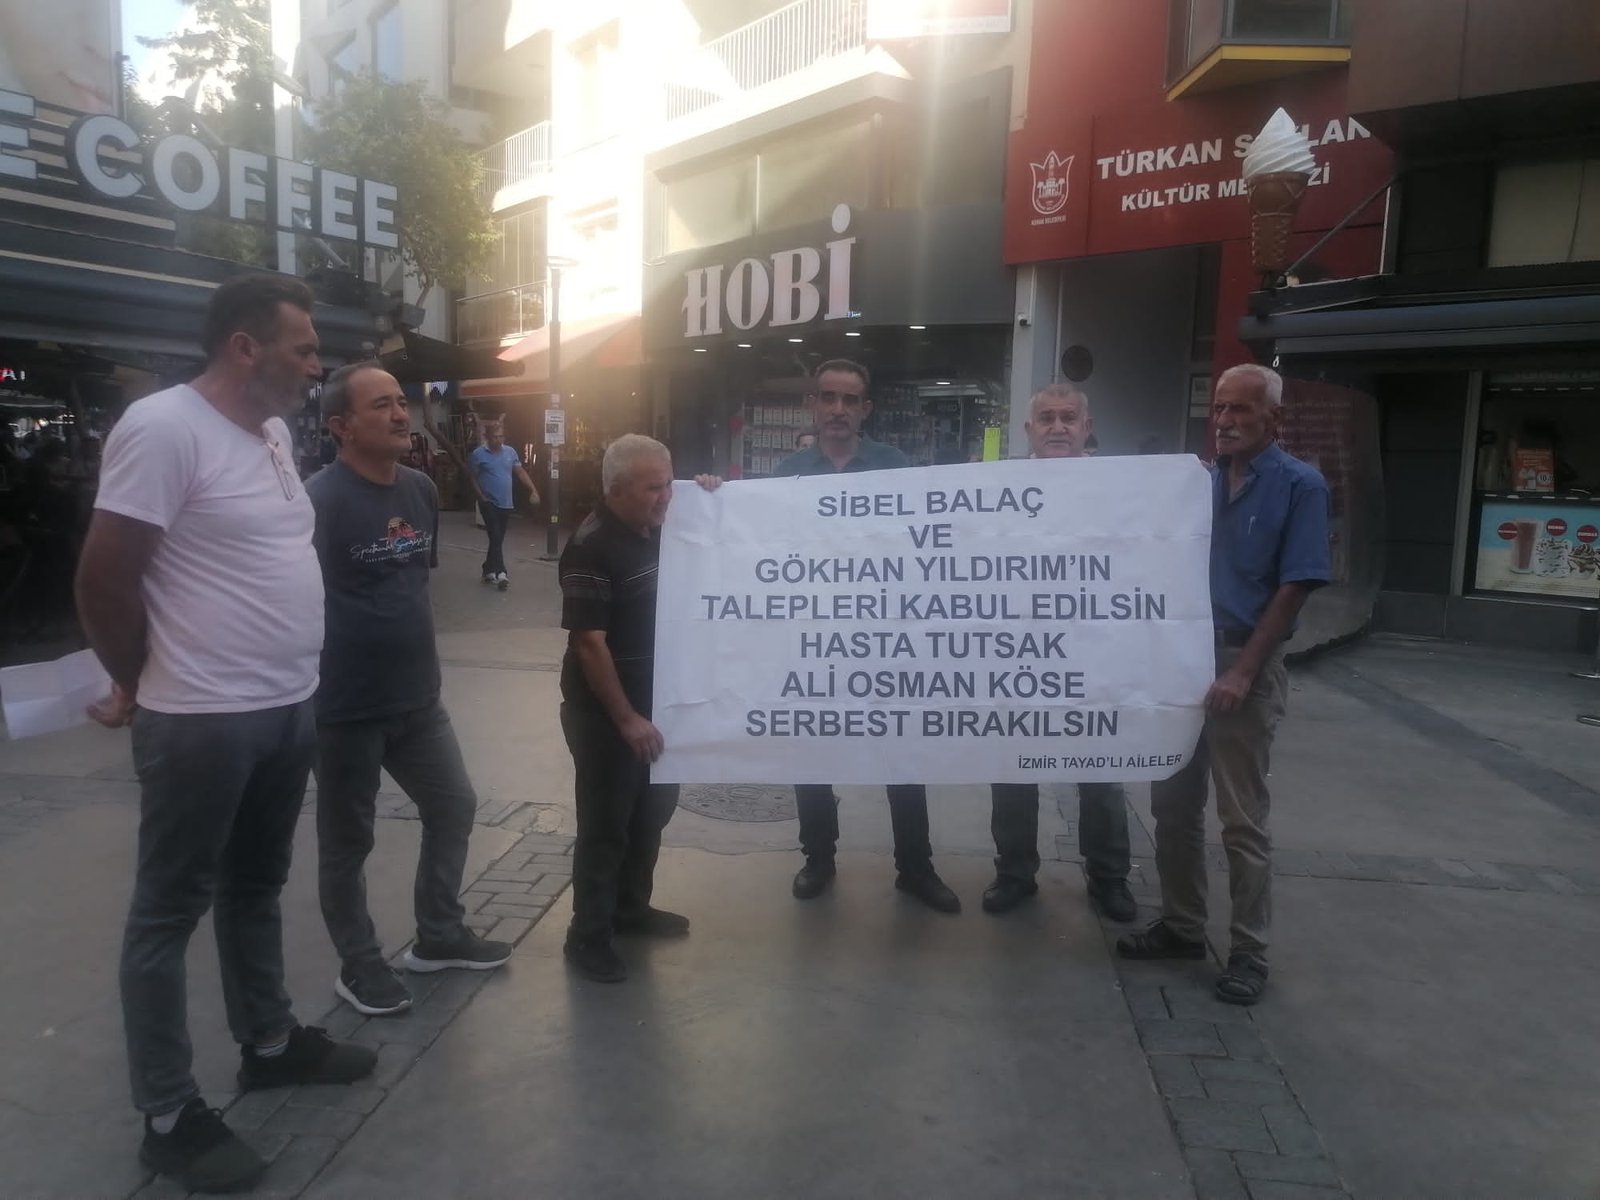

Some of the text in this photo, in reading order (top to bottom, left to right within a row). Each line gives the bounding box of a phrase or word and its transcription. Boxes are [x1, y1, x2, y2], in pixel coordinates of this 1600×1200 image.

[1097, 116, 1372, 180] TÜRKAN SLAN
[75, 114, 399, 249] COFFEE
[1121, 161, 1330, 212] KÜLTÜR MEZİ
[681, 203, 857, 338] HOBİ
[817, 486, 1044, 518] SİBEL BALAÇ
[907, 523, 953, 549] VE
[754, 553, 1111, 584] GÖKHAN YILDIRIM'IN
[701, 587, 1166, 621] TALEPLERİ KABUL EDİLSİN
[800, 631, 1067, 659] HASTA TUTSAK
[780, 664, 1086, 699] ALİ OSMAN KÖSE
[745, 709, 1119, 737] SERBEST BIRAKILSIN
[1017, 753, 1183, 769] İZMİR TAYAD'LI AİLELER
